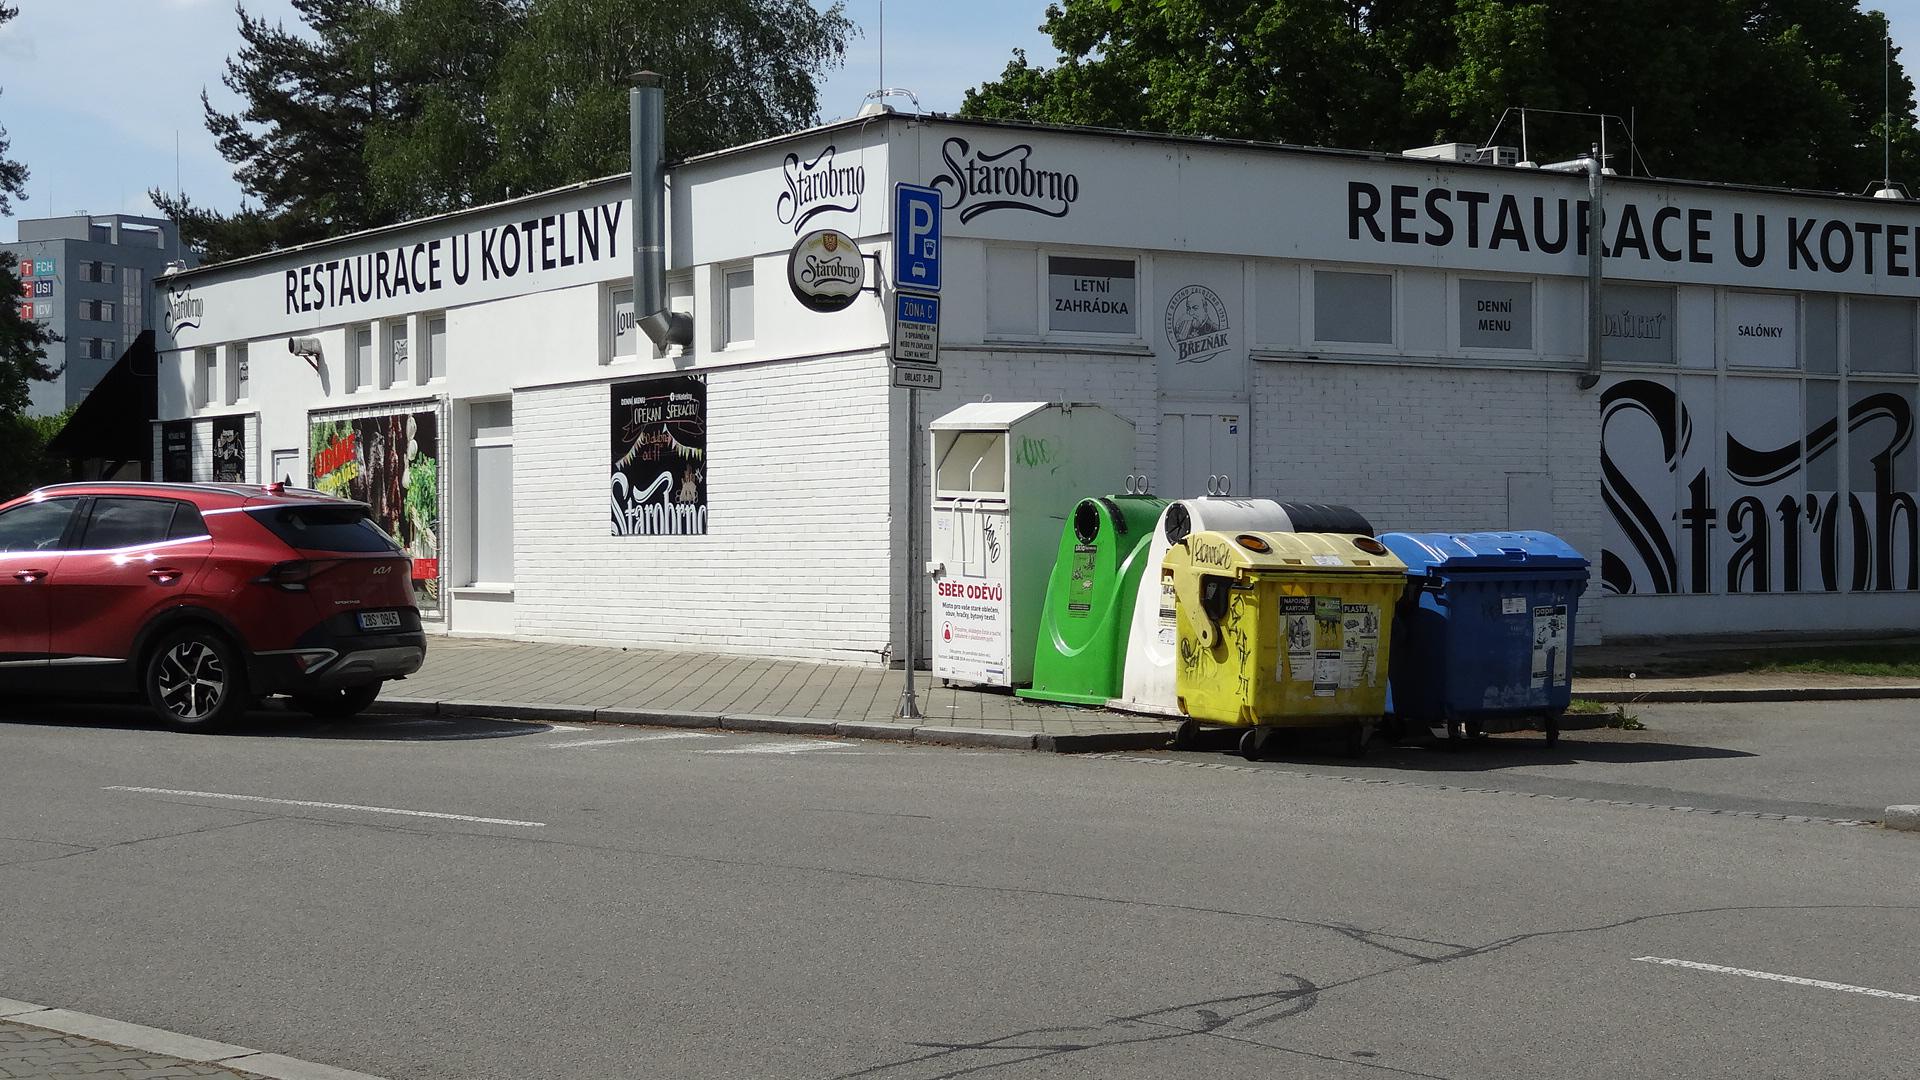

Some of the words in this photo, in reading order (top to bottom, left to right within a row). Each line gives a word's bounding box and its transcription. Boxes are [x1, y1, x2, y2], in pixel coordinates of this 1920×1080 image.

[777, 145, 865, 236] Starobrno
[930, 137, 1079, 225] Starobrno
[909, 199, 934, 256] P
[1348, 181, 1713, 264] RESTAURACE
[1734, 213, 1766, 268] U
[1787, 216, 1920, 278] KOTE
[35, 261, 53, 273] FCH
[286, 240, 441, 315] RESTAURACE
[452, 233, 469, 286] U
[482, 201, 622, 282] KOTELNY
[801, 255, 859, 289] Starobrno
[1073, 277, 1110, 293] LETNÍ
[927, 304, 933, 319] C
[1055, 297, 1129, 315] ZAHRÁDKA
[1477, 299, 1512, 313] DENNÍ
[1478, 320, 1511, 332] MENU
[1738, 322, 1783, 338] SALÓNKY
[611, 471, 706, 535] Starobrno
[939, 580, 964, 598] SBĚR
[967, 582, 1003, 602] ODĚVŮ
